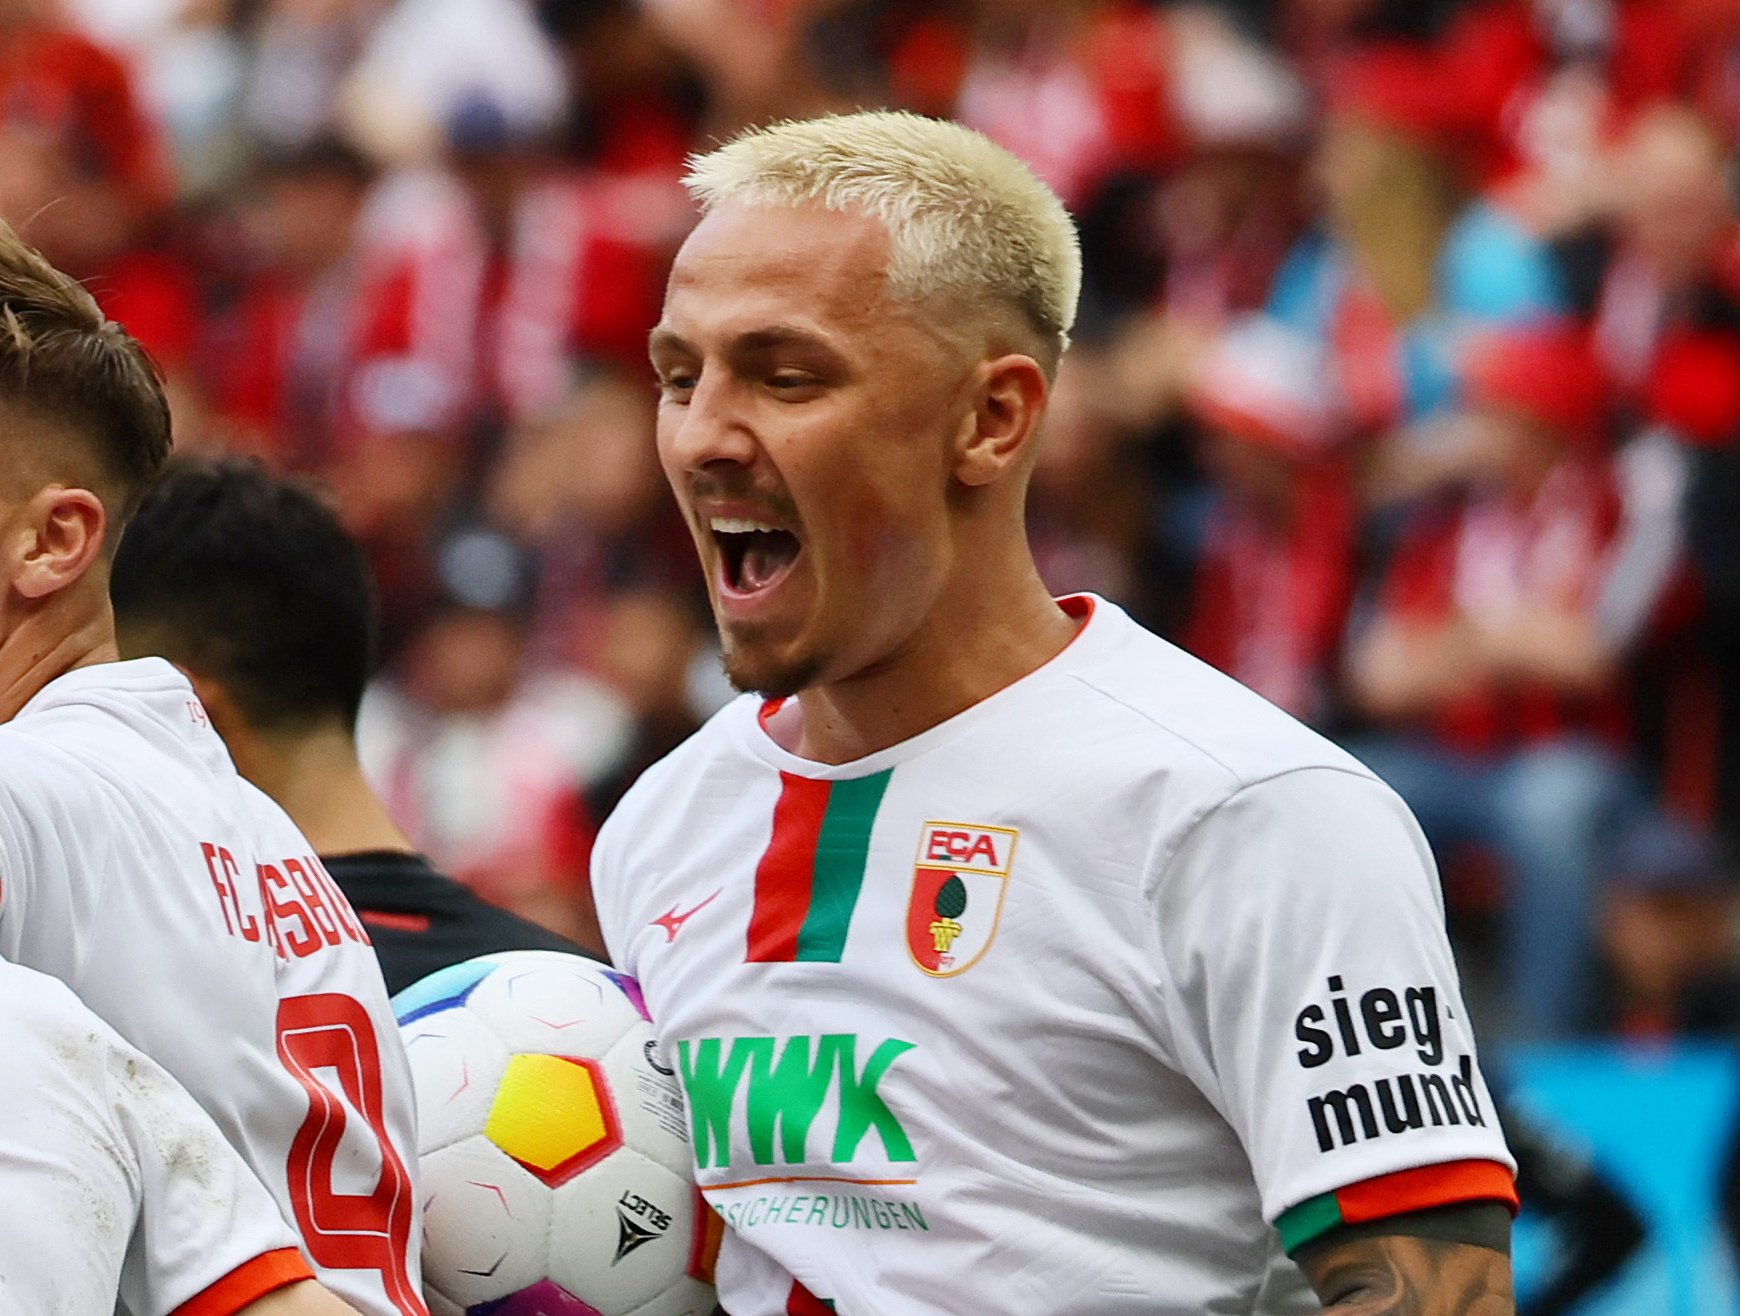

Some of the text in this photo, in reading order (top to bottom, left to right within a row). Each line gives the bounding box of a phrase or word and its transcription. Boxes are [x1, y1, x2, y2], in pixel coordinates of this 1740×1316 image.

[199, 841, 261, 943] FC
[926, 830, 998, 867] FCA
[677, 1032, 918, 1169] WWK
[1307, 1054, 1488, 1153] mund
[618, 1189, 673, 1231] SELECT
